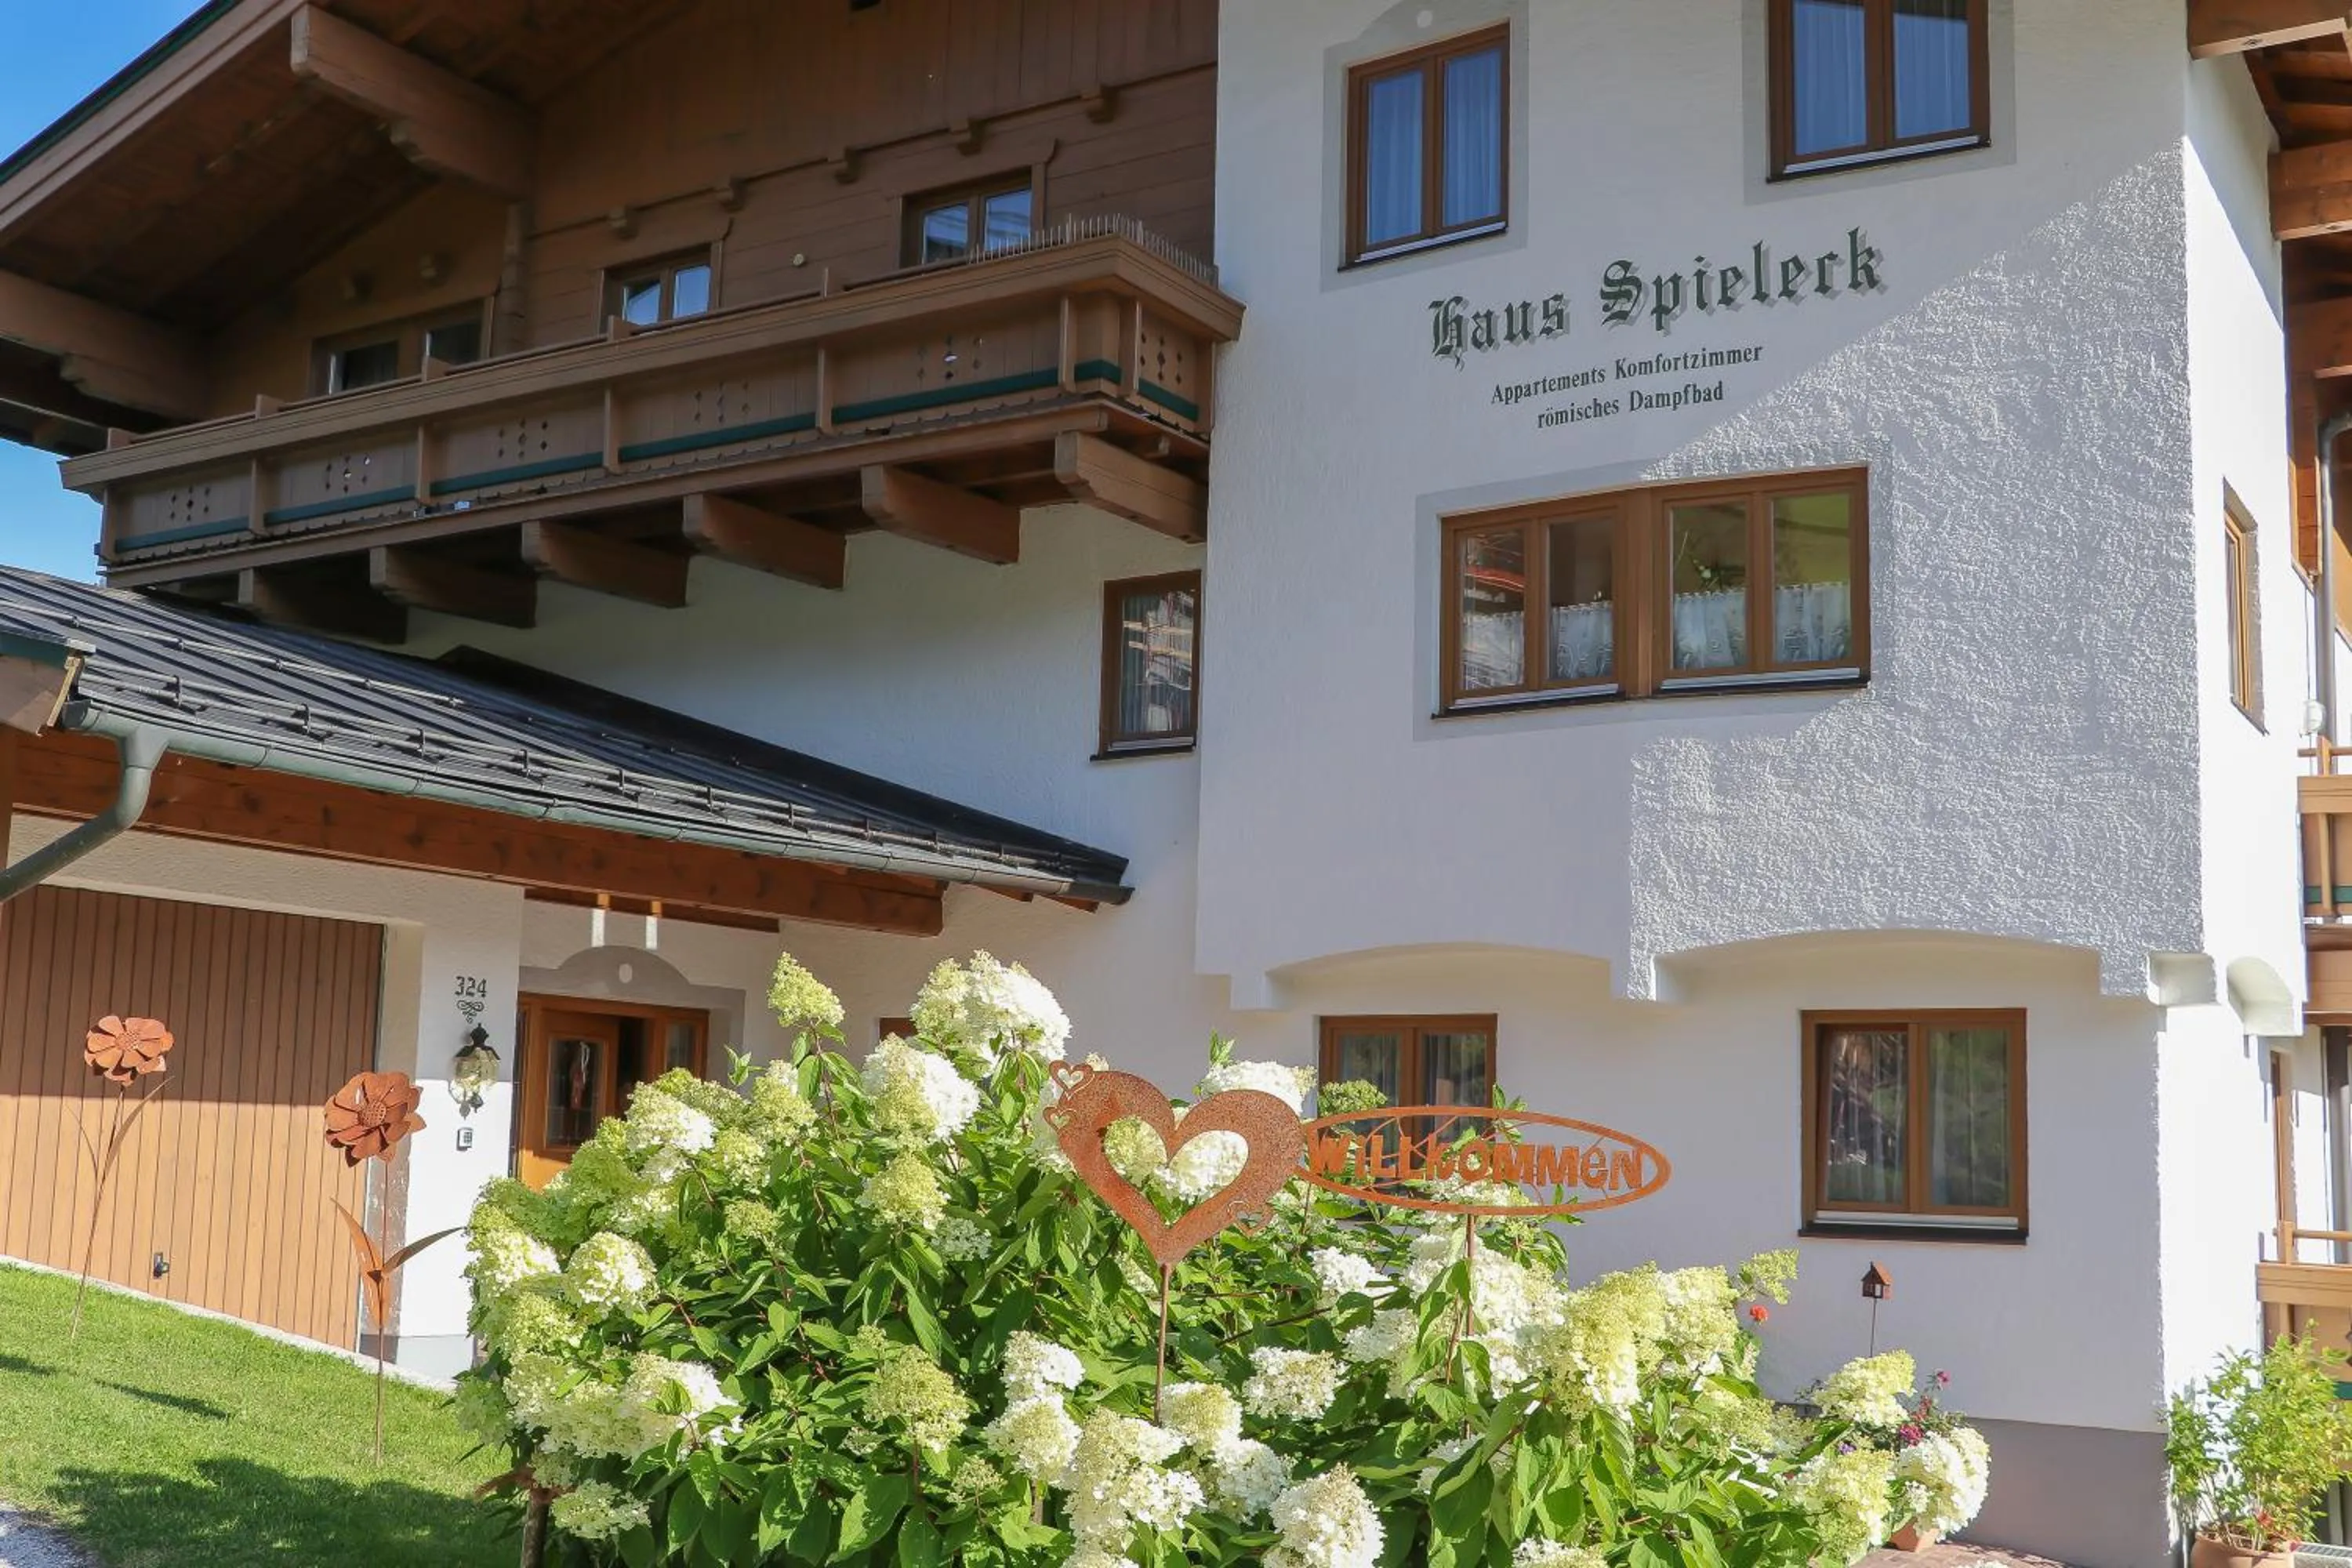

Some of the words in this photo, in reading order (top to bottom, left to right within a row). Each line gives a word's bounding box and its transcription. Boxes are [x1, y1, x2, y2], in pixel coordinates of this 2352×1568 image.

[1428, 292, 1566, 370] Haus
[1492, 366, 1606, 405] Appartements
[1615, 345, 1762, 379] Komfortzimmer
[1537, 397, 1619, 428] römisches
[1629, 380, 1724, 412] Dampfbad
[455, 976, 488, 998] 324
